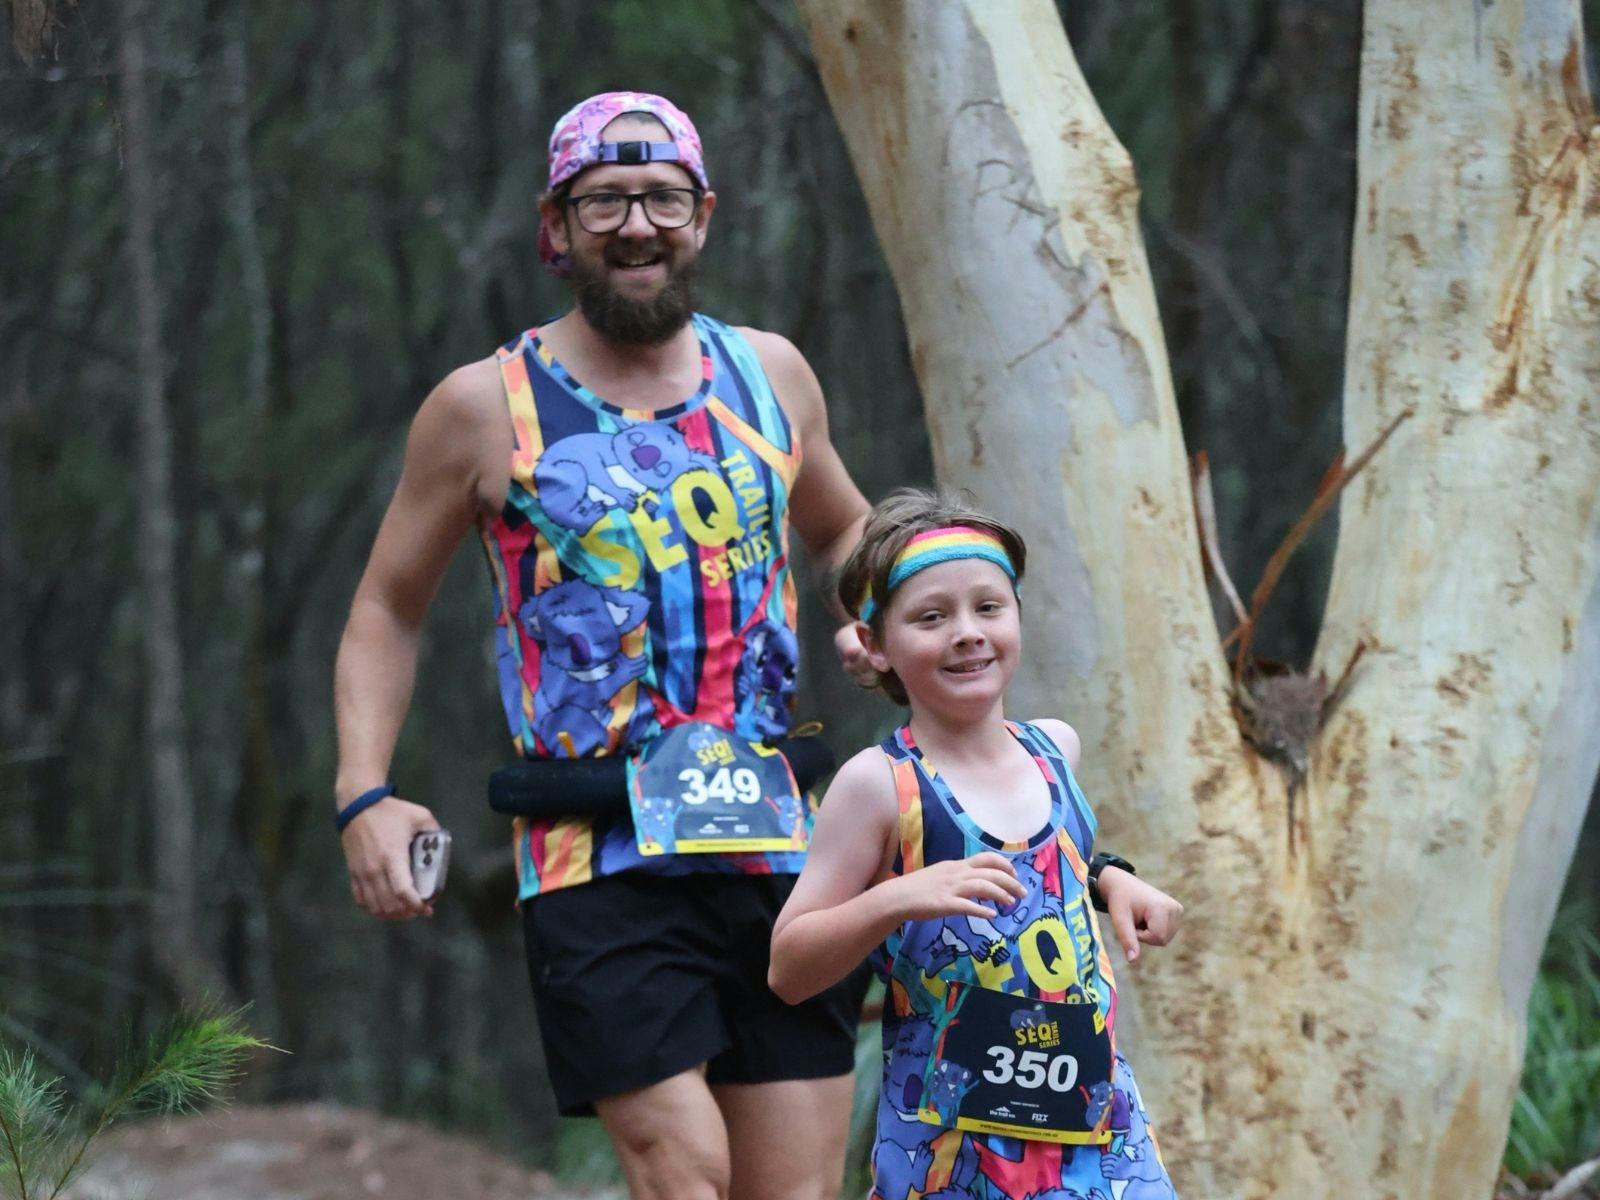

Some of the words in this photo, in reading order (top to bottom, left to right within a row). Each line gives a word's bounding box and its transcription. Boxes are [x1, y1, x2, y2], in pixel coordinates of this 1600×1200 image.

[720, 449, 771, 538] TRAIL
[580, 467, 746, 592] SEQ
[700, 530, 772, 588] SERIES
[678, 767, 761, 805] 349
[1064, 893, 1096, 979] TRAIL
[1015, 1023, 1052, 1046] SEQ
[1038, 1038, 1061, 1049] SERIES
[982, 1045, 1079, 1093] 350
